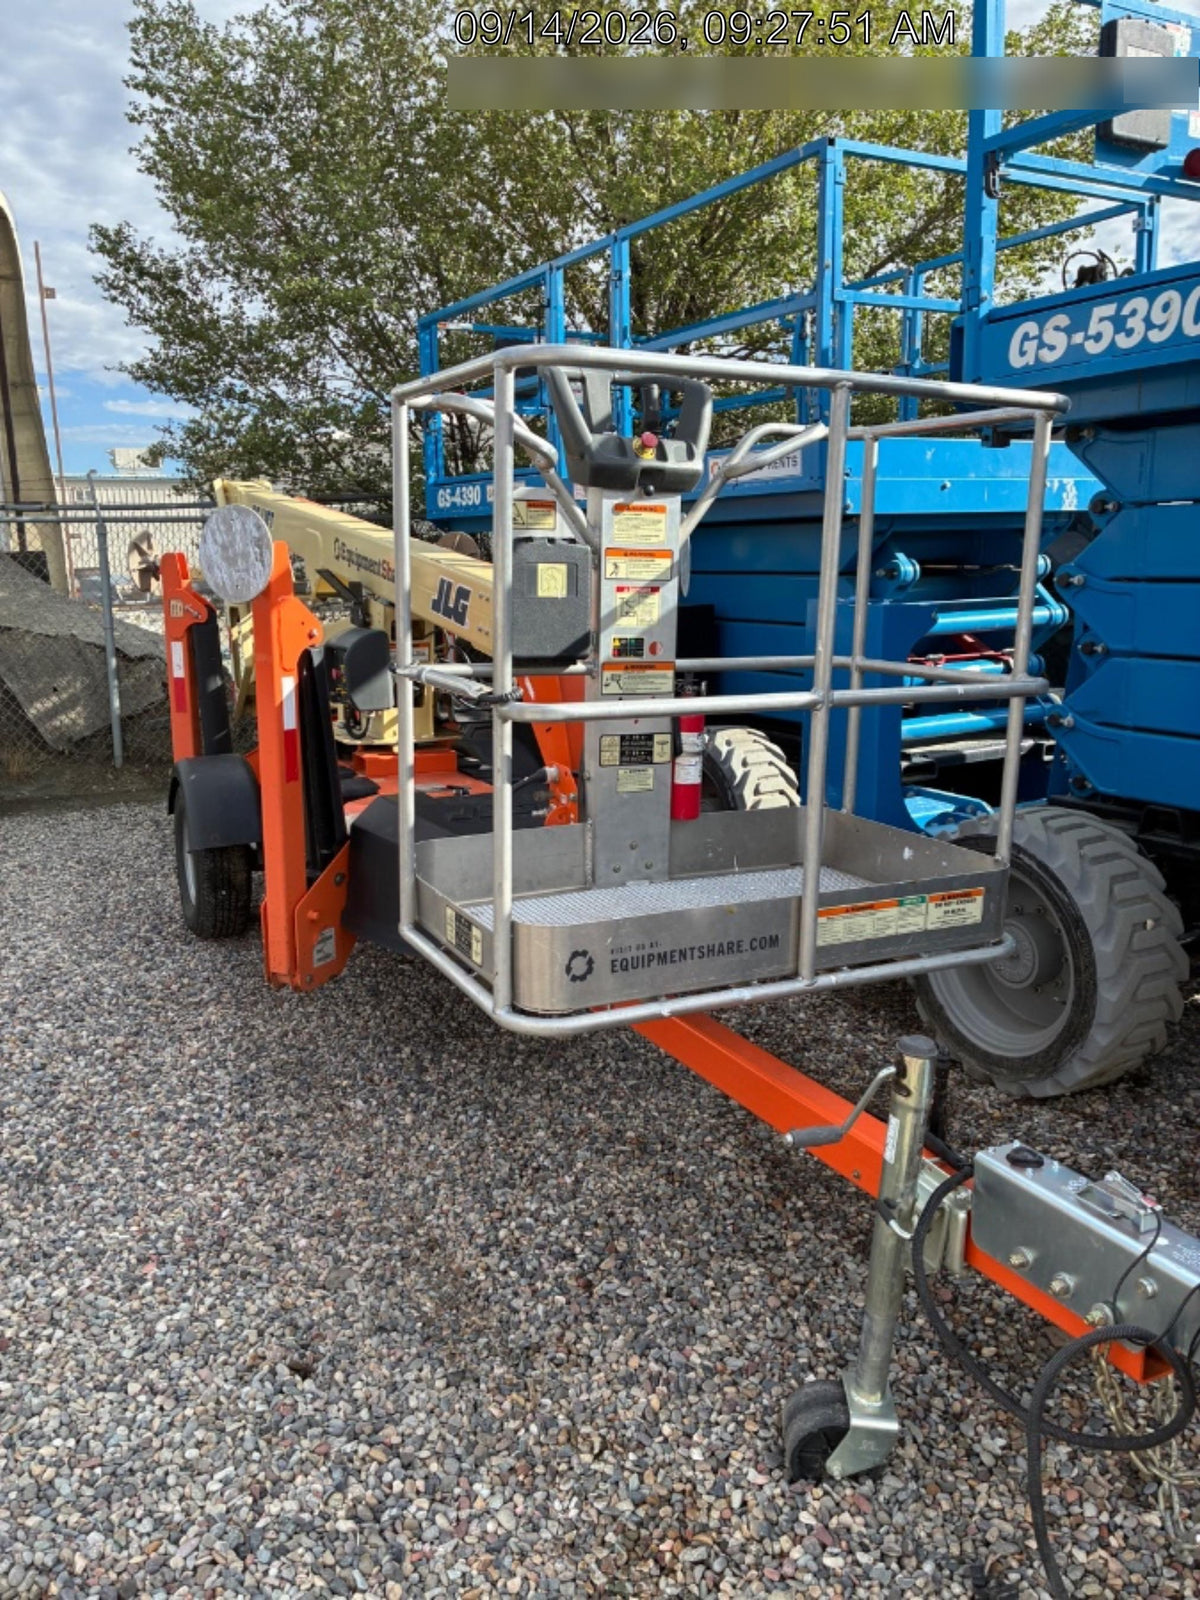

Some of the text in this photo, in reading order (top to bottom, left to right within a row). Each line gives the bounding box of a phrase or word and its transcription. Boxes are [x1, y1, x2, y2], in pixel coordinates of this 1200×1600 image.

[437, 485, 481, 508] GS-4390
[431, 576, 472, 627] JLG
[610, 934, 780, 974] EQUIPMENTSHARE.COM
